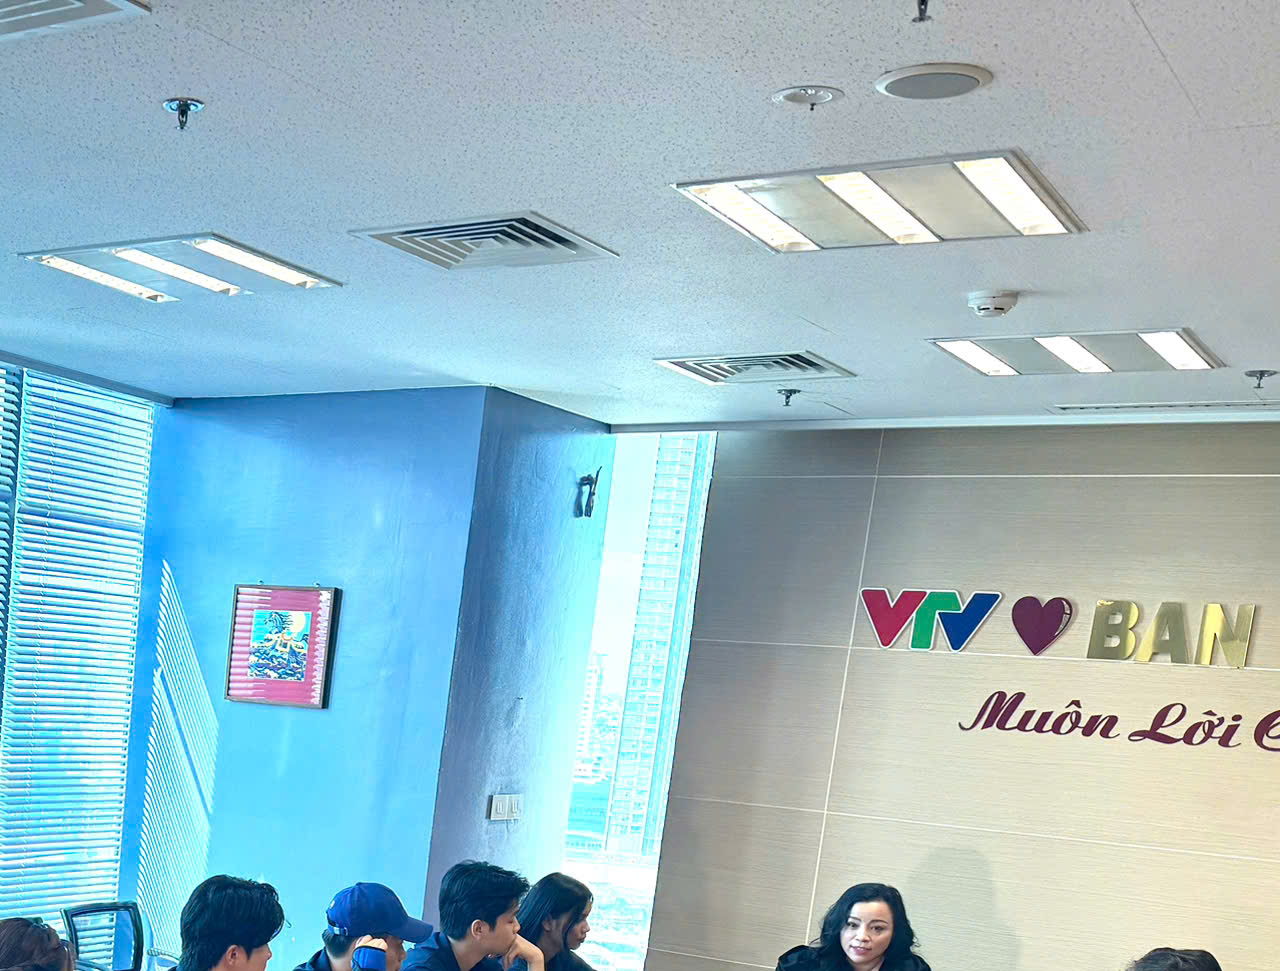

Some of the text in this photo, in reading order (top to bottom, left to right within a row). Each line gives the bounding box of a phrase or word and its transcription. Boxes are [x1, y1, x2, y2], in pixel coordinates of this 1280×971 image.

[859, 586, 1256, 667] VTV BAN
[958, 690, 1121, 739] Muôn
[1127, 702, 1243, 748] Lời
